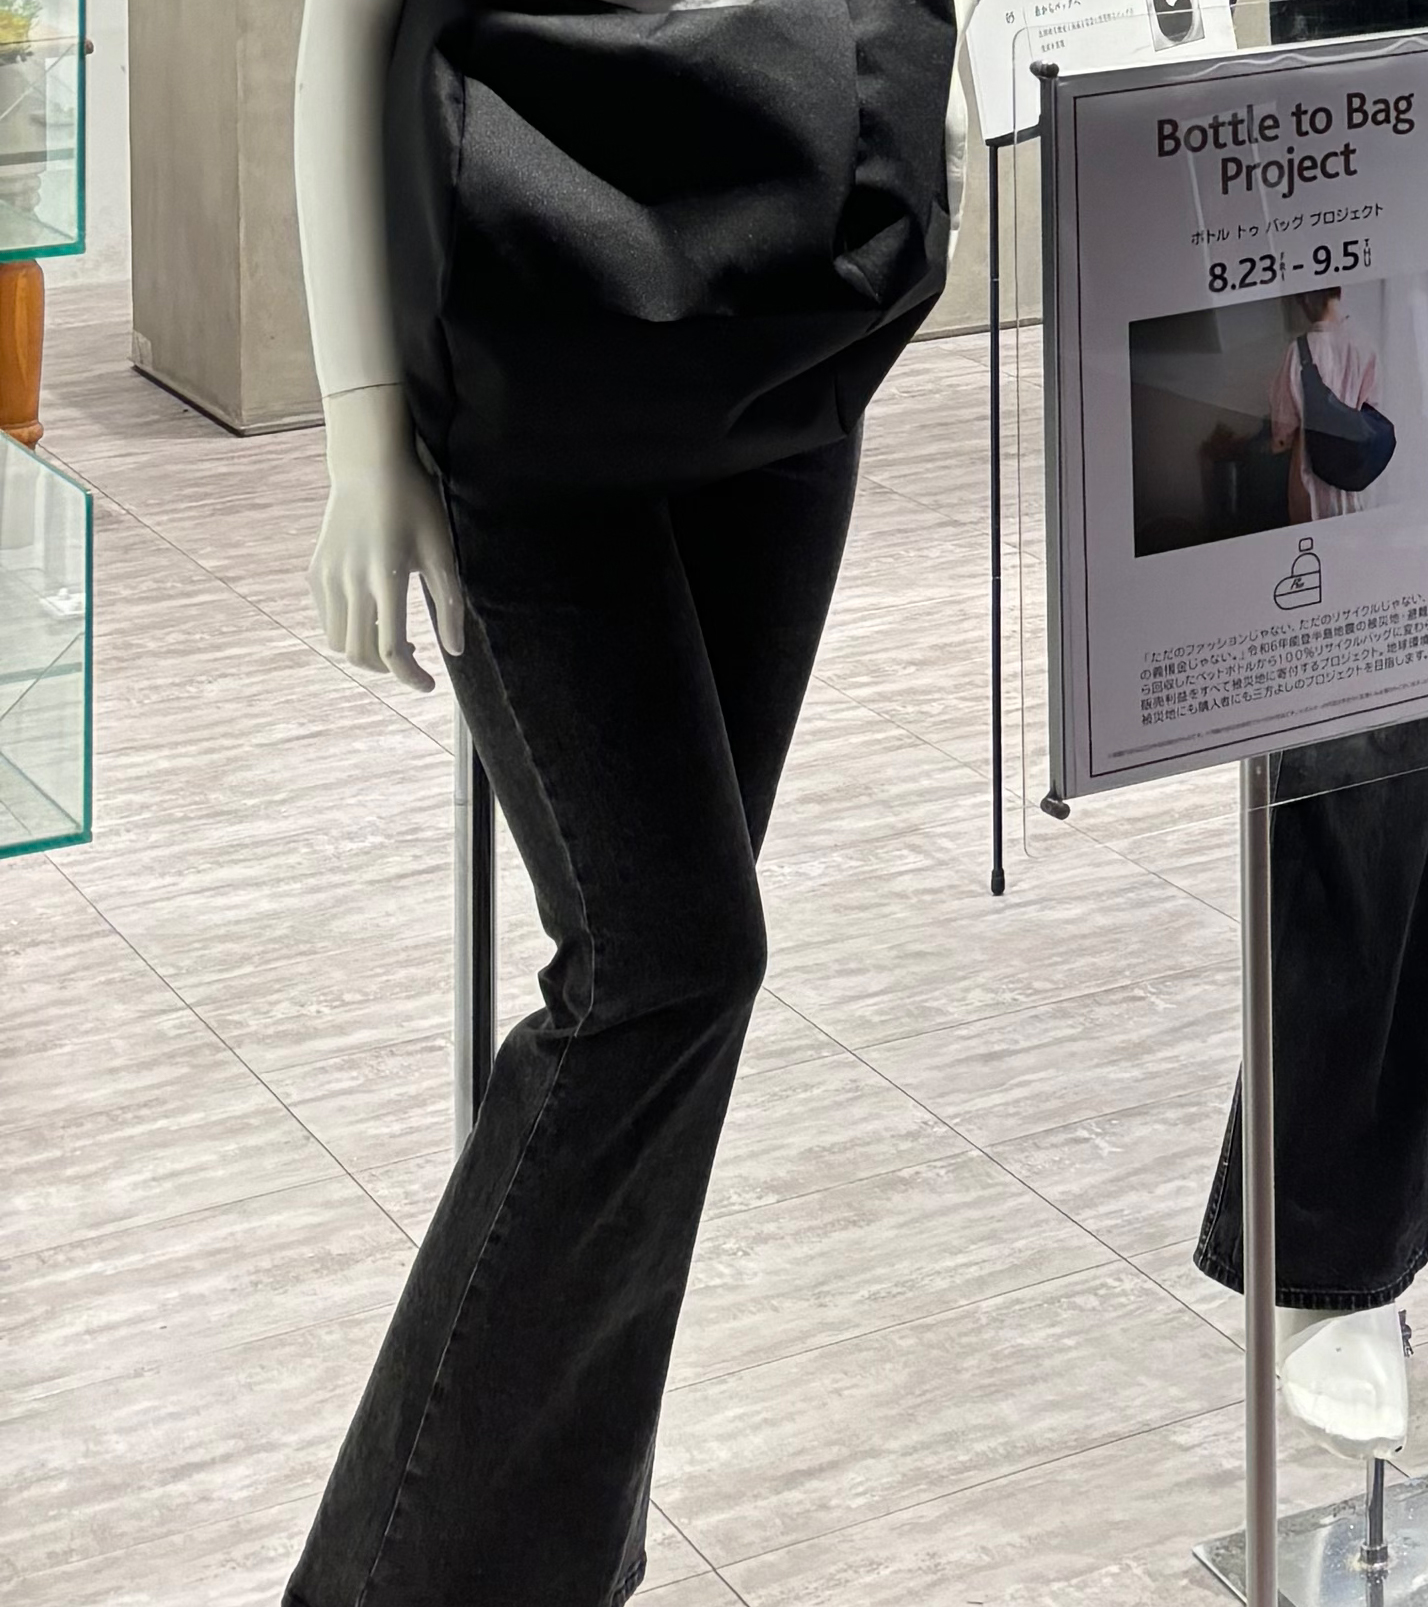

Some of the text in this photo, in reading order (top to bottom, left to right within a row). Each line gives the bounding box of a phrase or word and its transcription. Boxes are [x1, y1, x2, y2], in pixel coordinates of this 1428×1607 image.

[1157, 92, 1415, 157] Bottle to Bag
[1221, 142, 1358, 198] Project
[1191, 205, 1384, 245] ボトル トゥ バッグ プロジェクト
[1208, 254, 1277, 293] 8.23
[1312, 240, 1359, 276] 9.5
